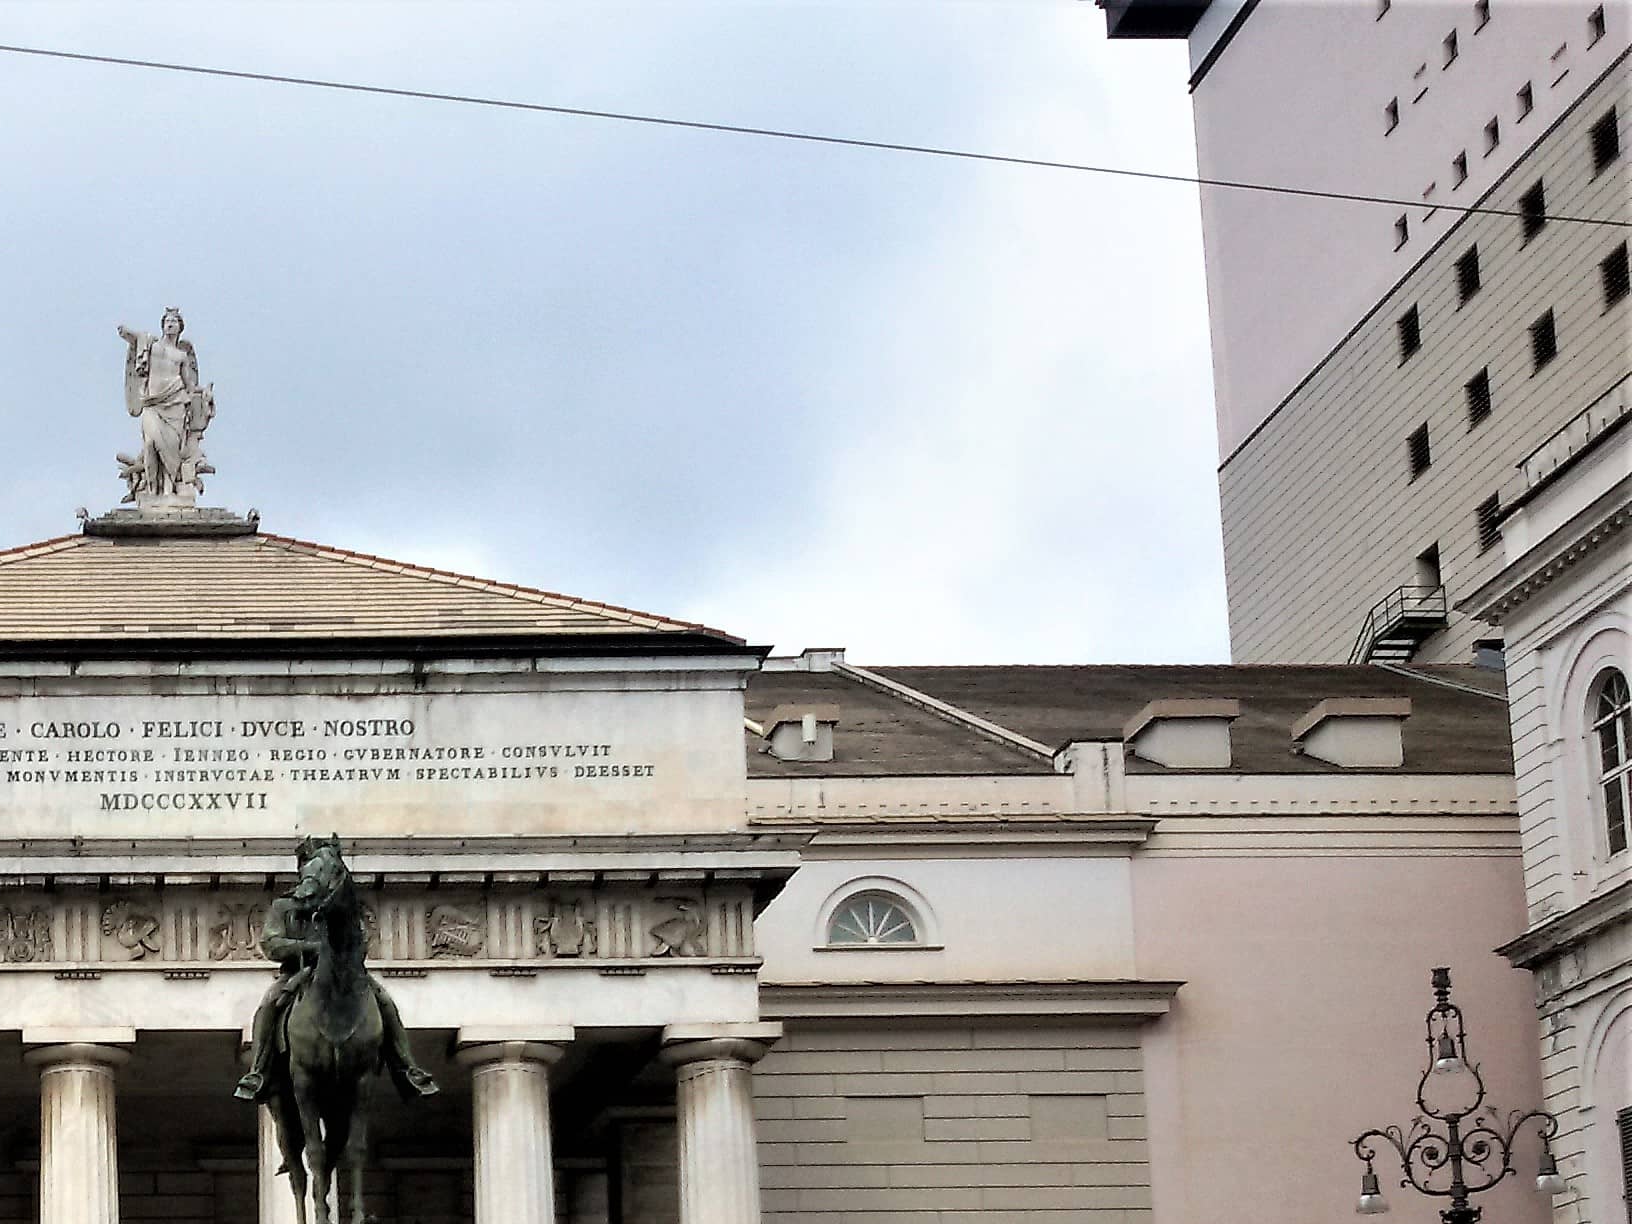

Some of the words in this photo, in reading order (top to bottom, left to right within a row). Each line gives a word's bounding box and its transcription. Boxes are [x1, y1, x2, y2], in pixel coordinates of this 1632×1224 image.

[30, 720, 121, 739] CAROLO
[141, 720, 223, 738] FELICI
[241, 720, 305, 738] DVCE
[324, 719, 416, 737] NOSTRO
[67, 749, 154, 762] HECTORE
[270, 749, 327, 761] REGIO
[343, 747, 485, 761] GVBERNATORE
[501, 745, 612, 759] CONSVLVIT
[7, 770, 139, 783] MONVMENTIS
[155, 769, 275, 783] INSTRVCTAE
[290, 768, 401, 781] THEATRVM
[415, 766, 558, 780] SPECTABILIVS
[574, 765, 655, 778] DEESSET
[99, 792, 268, 811] MDCCCXXVII
